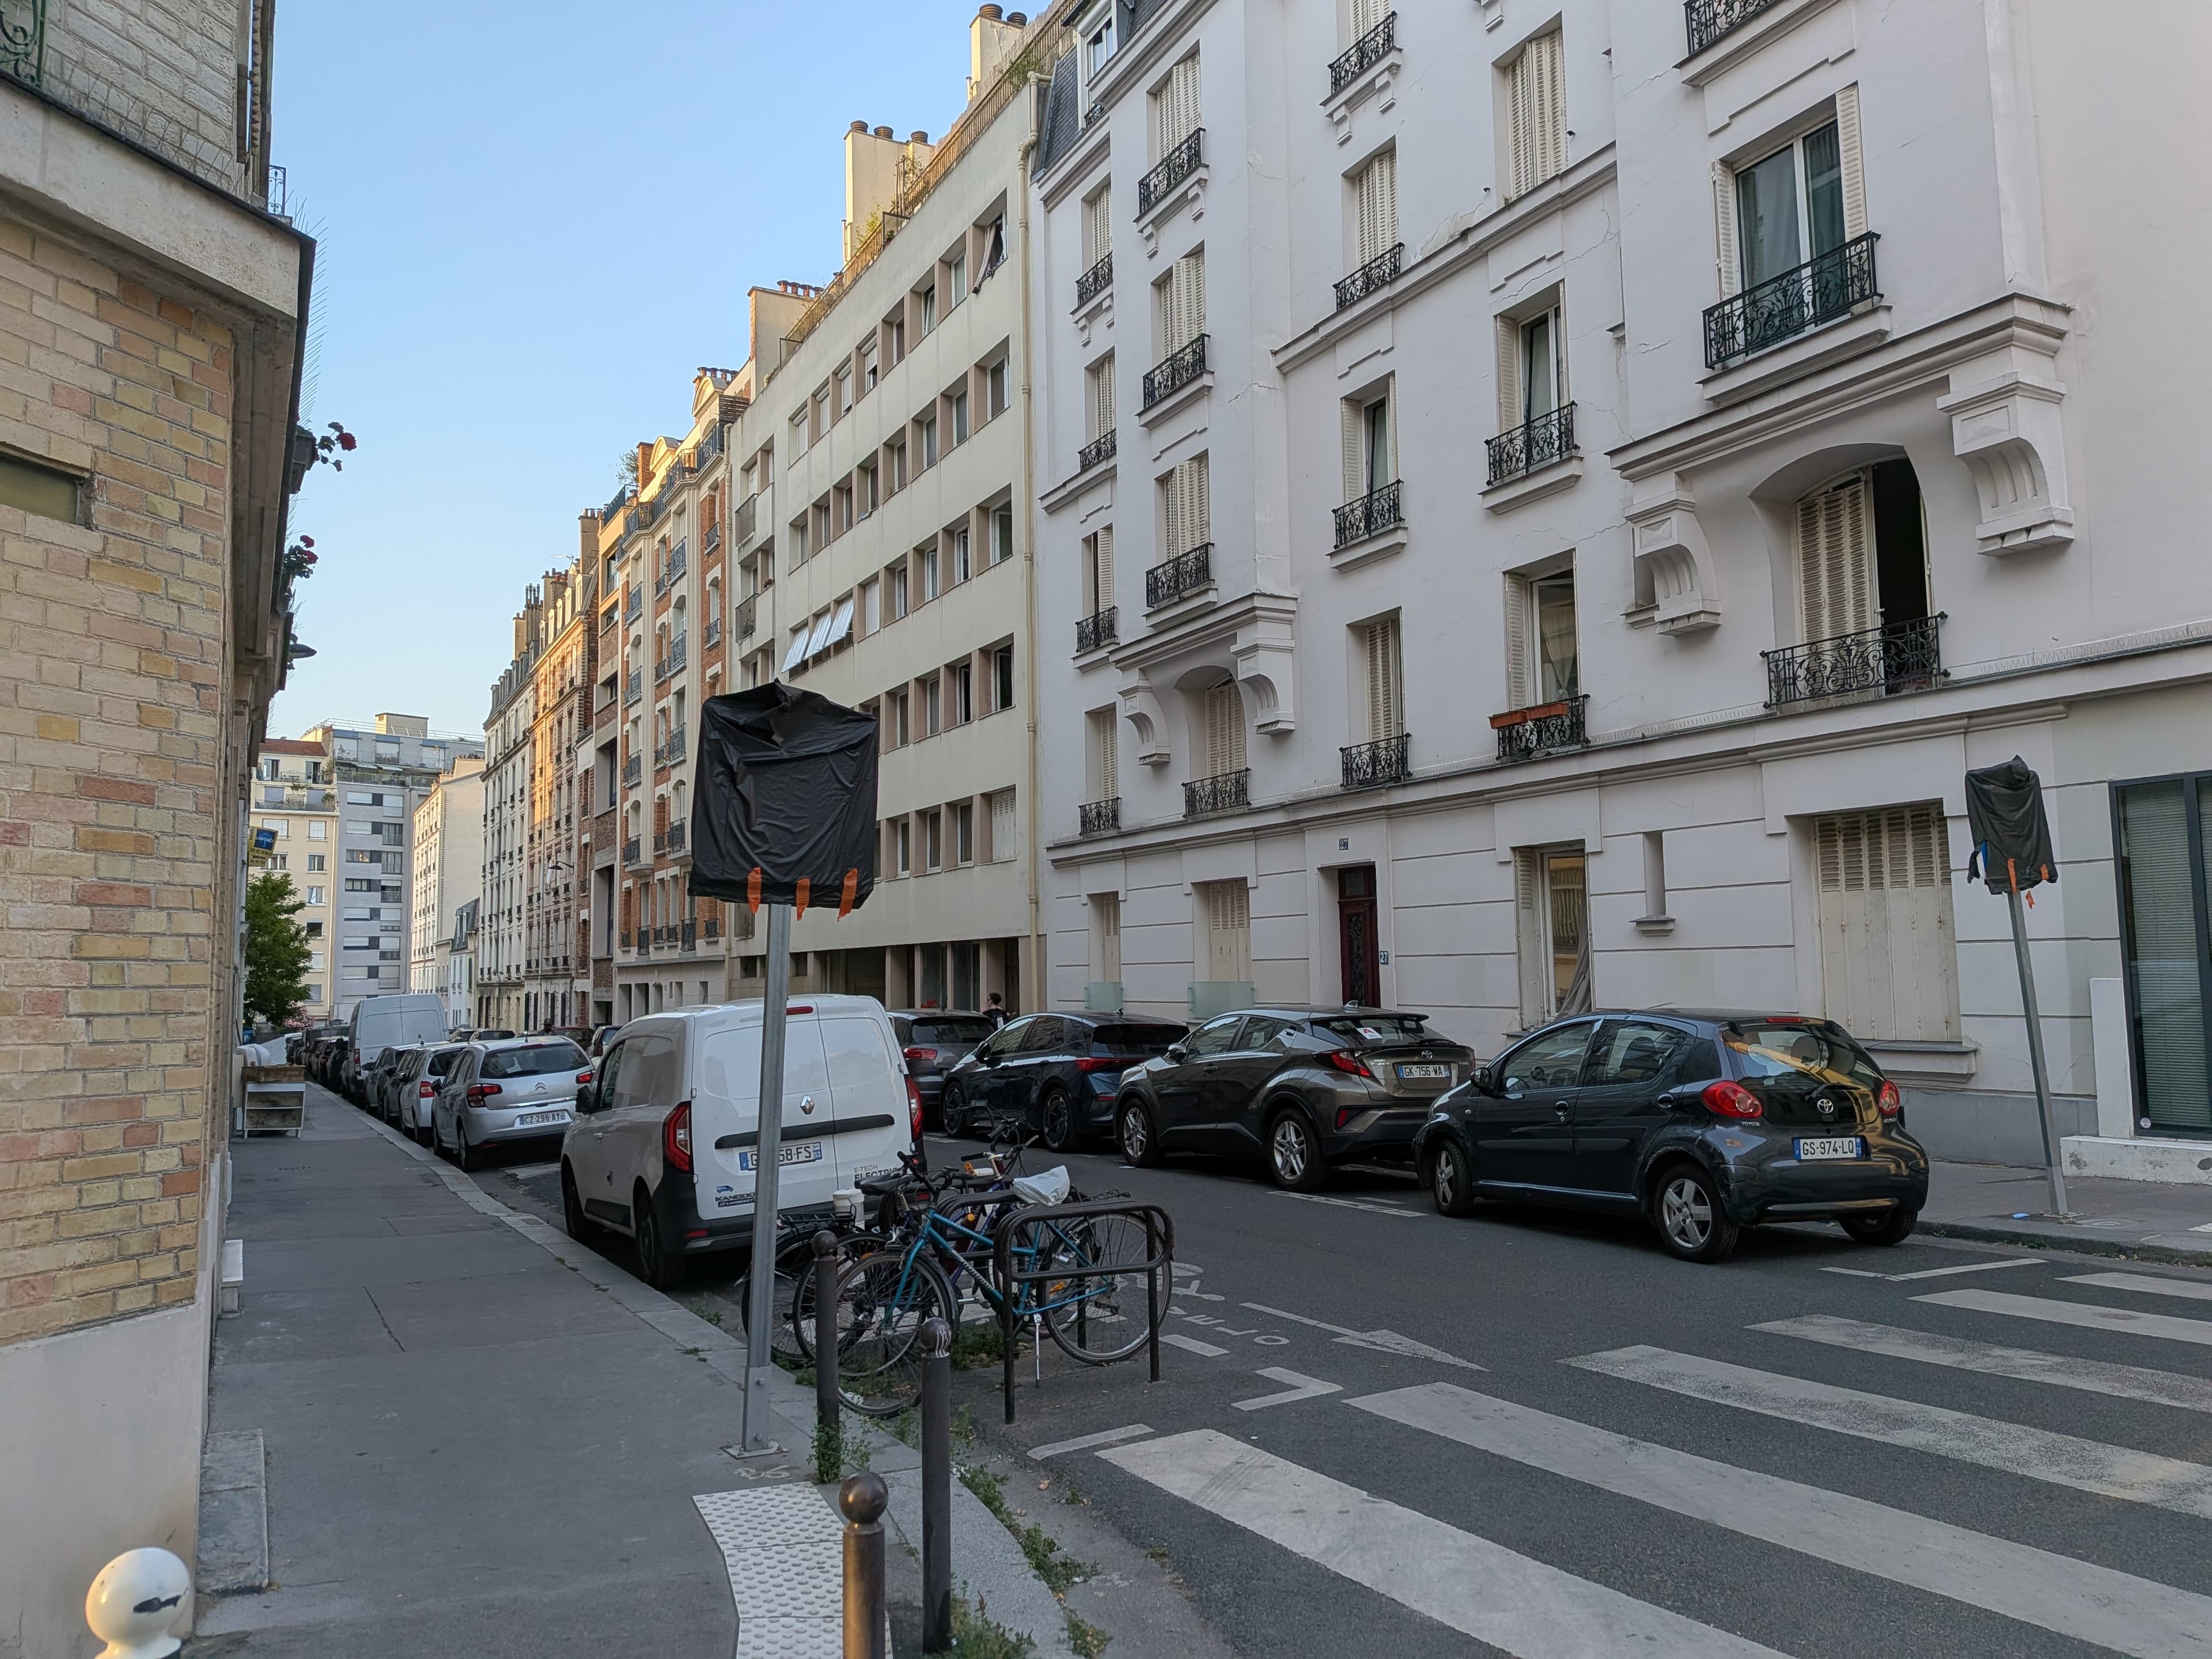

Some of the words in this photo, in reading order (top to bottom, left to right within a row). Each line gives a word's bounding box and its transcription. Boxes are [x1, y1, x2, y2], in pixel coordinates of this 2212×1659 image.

[1340, 839, 1348, 849] 27
[1380, 952, 1387, 963] 27
[1405, 1066, 1443, 1077] GK-756-WA
[524, 1112, 560, 1124] CZ-296-AY
[1802, 1140, 1854, 1156] GS-974-LQ
[854, 1164, 878, 1173] E-TECH
